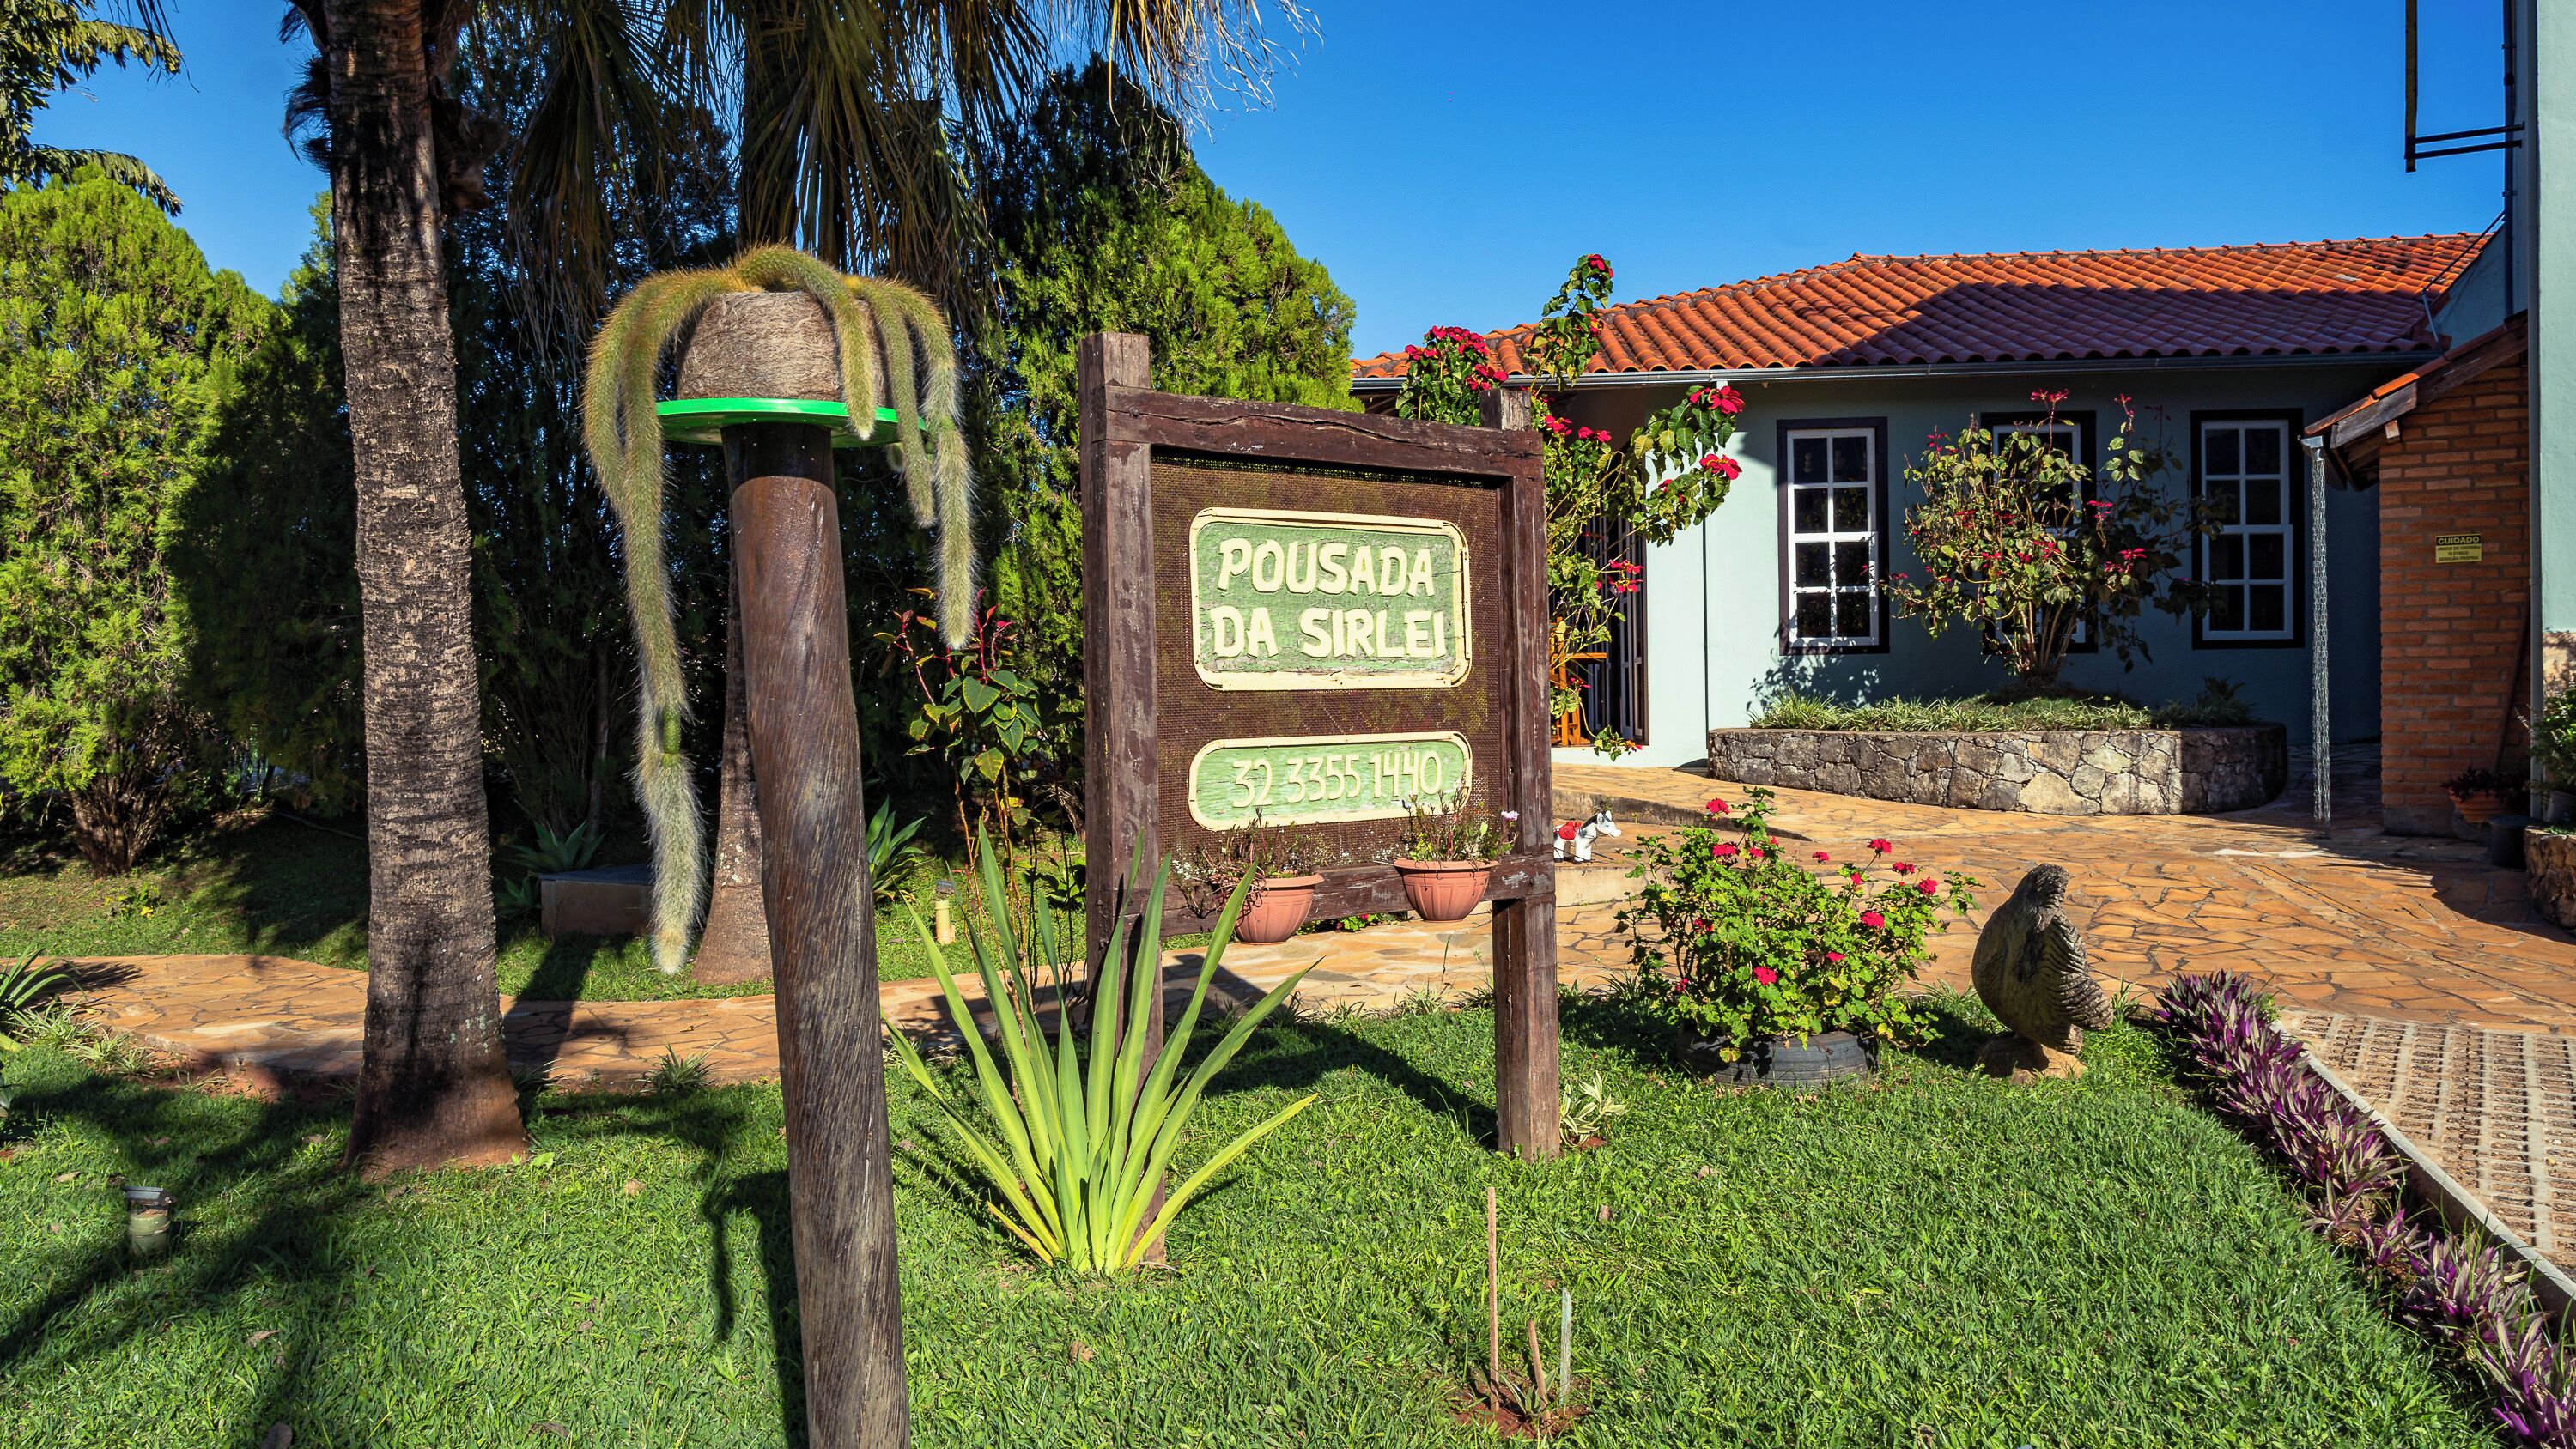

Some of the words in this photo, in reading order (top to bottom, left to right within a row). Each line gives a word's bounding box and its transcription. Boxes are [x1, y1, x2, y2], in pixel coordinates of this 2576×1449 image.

[1217, 537, 1435, 598] POUSADA
[2438, 536, 2480, 544] CUIDADO
[1210, 605, 1280, 658] DA
[1299, 607, 1447, 659] SIRLEI
[1231, 758, 1273, 809] 32
[1286, 753, 1362, 804] 3355
[1368, 750, 1443, 799] 1440
